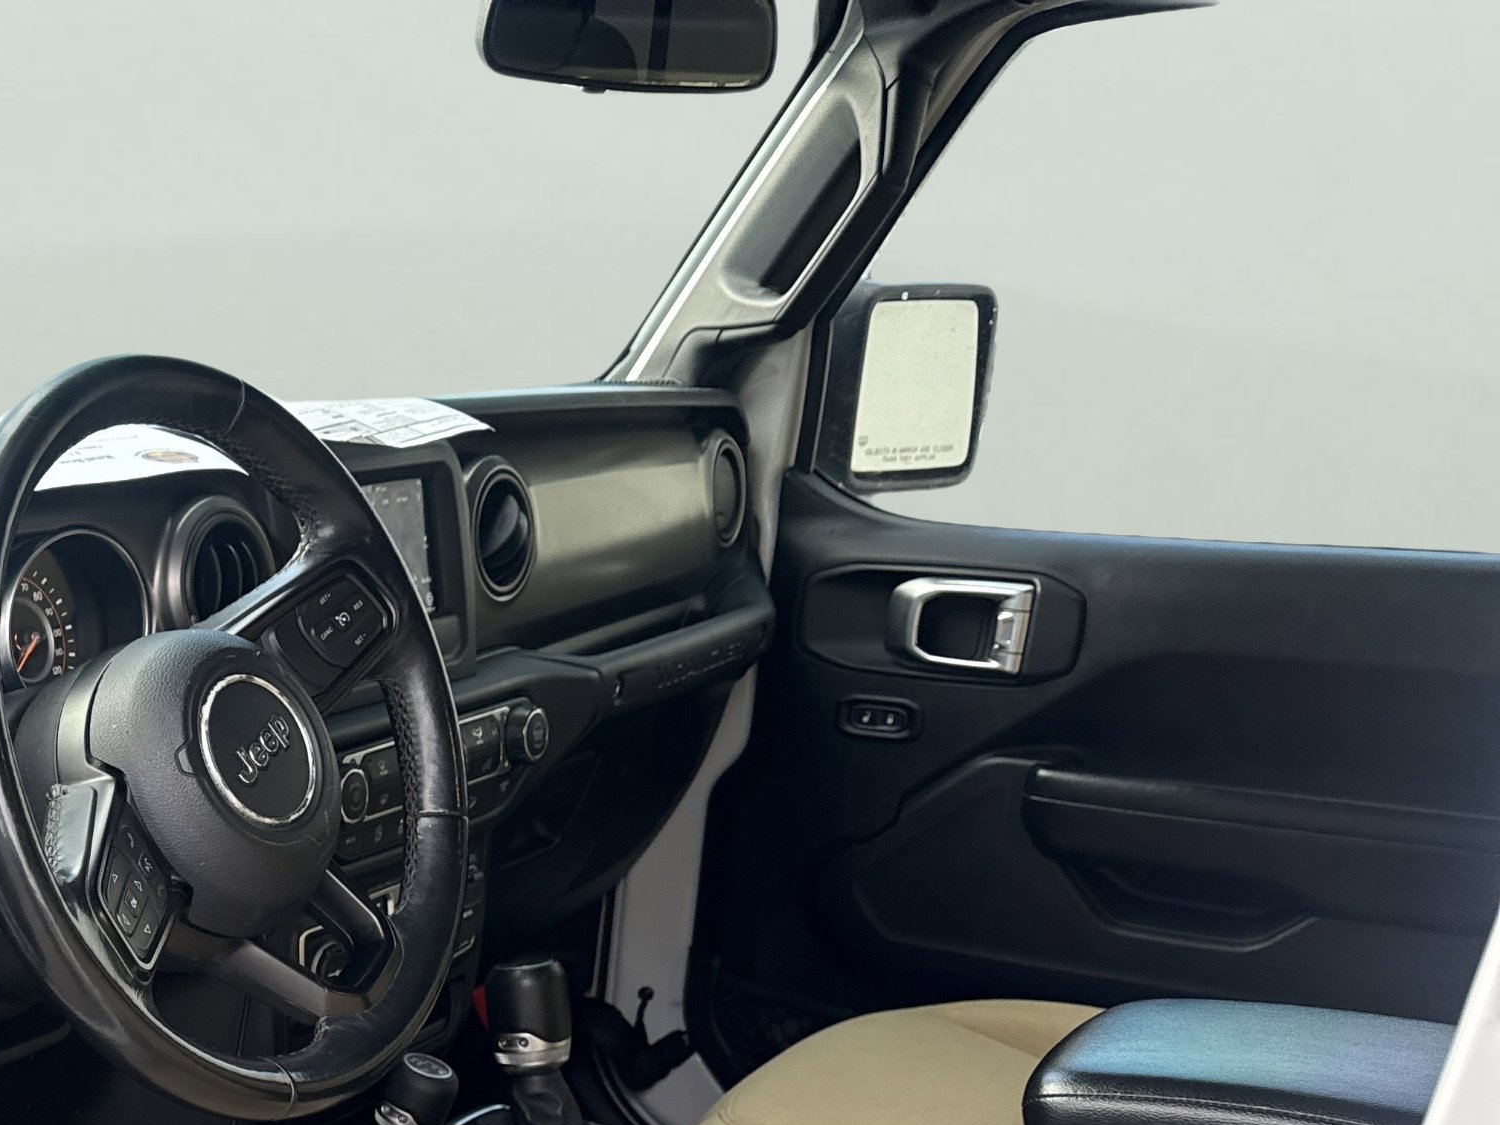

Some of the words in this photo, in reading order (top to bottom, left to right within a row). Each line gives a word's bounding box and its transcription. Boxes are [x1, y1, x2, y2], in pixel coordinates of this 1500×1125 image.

[21, 582, 29, 592] 70
[33, 590, 43, 601] 80
[236, 714, 290, 784] Jeep
